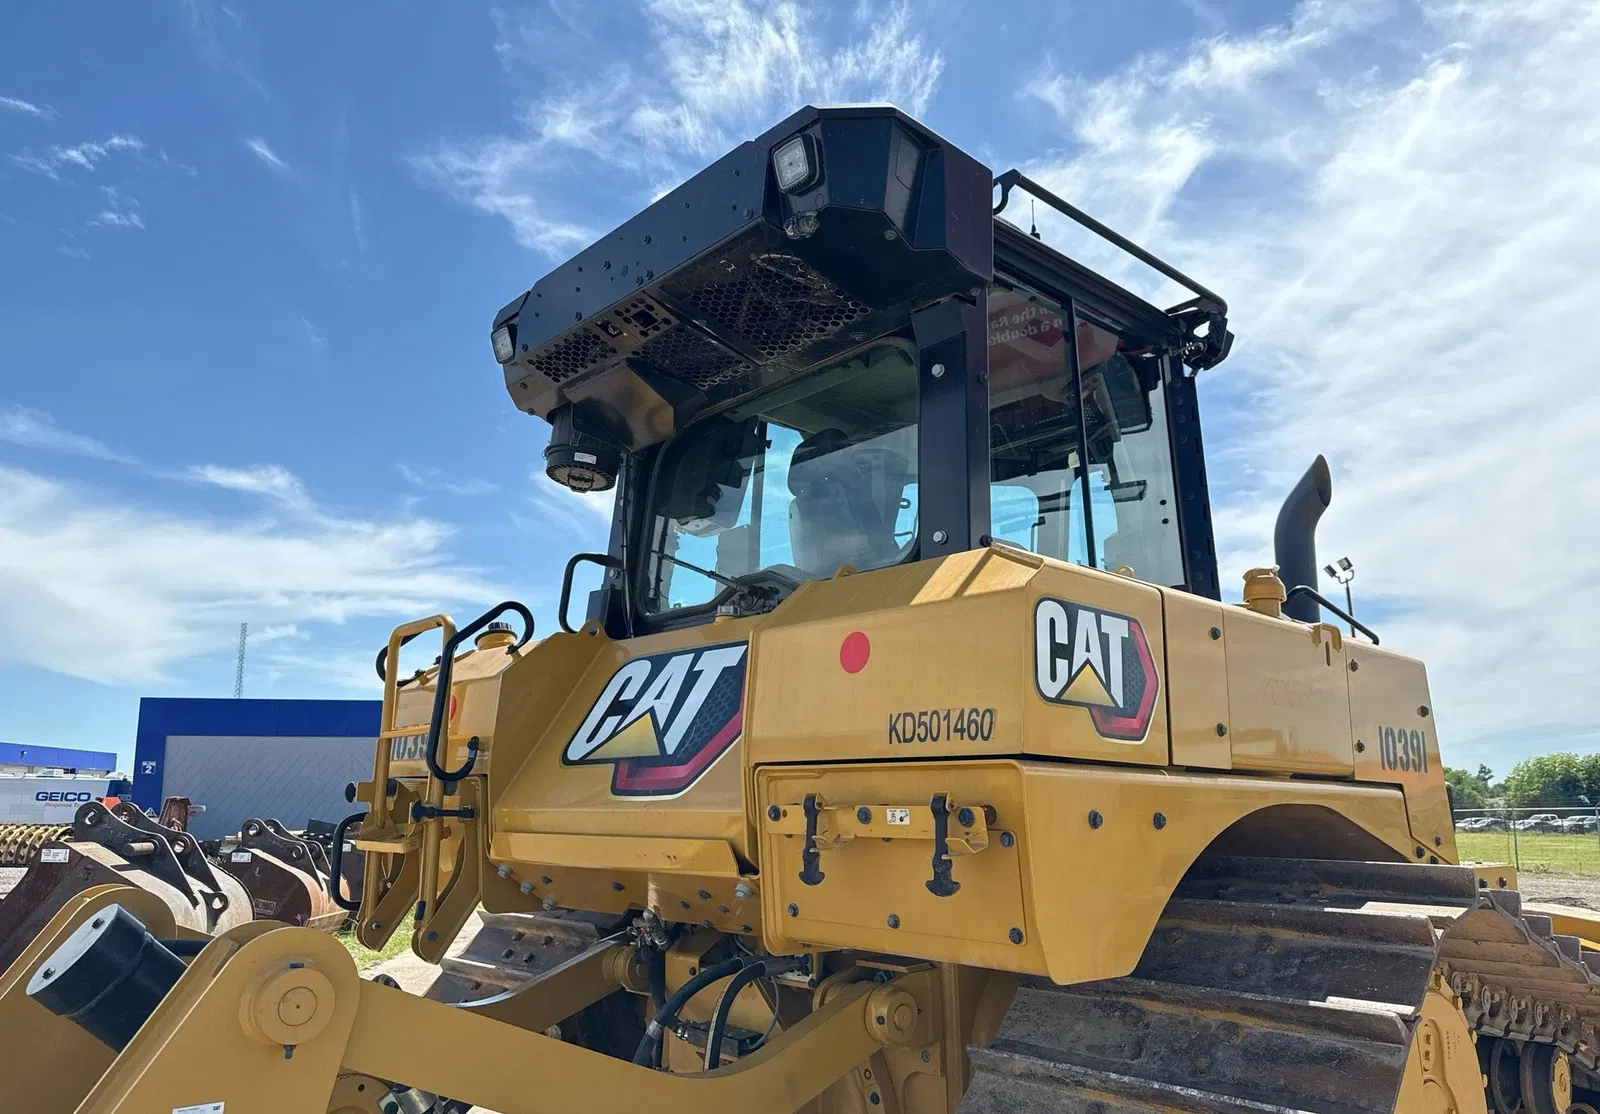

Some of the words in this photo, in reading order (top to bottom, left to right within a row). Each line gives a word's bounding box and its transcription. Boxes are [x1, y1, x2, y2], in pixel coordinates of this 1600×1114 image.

[1036, 600, 1129, 708] CAT
[566, 645, 748, 761] CAT
[888, 707, 994, 744] KD501460
[145, 765, 152, 774] 2
[35, 791, 92, 802] GEICO
